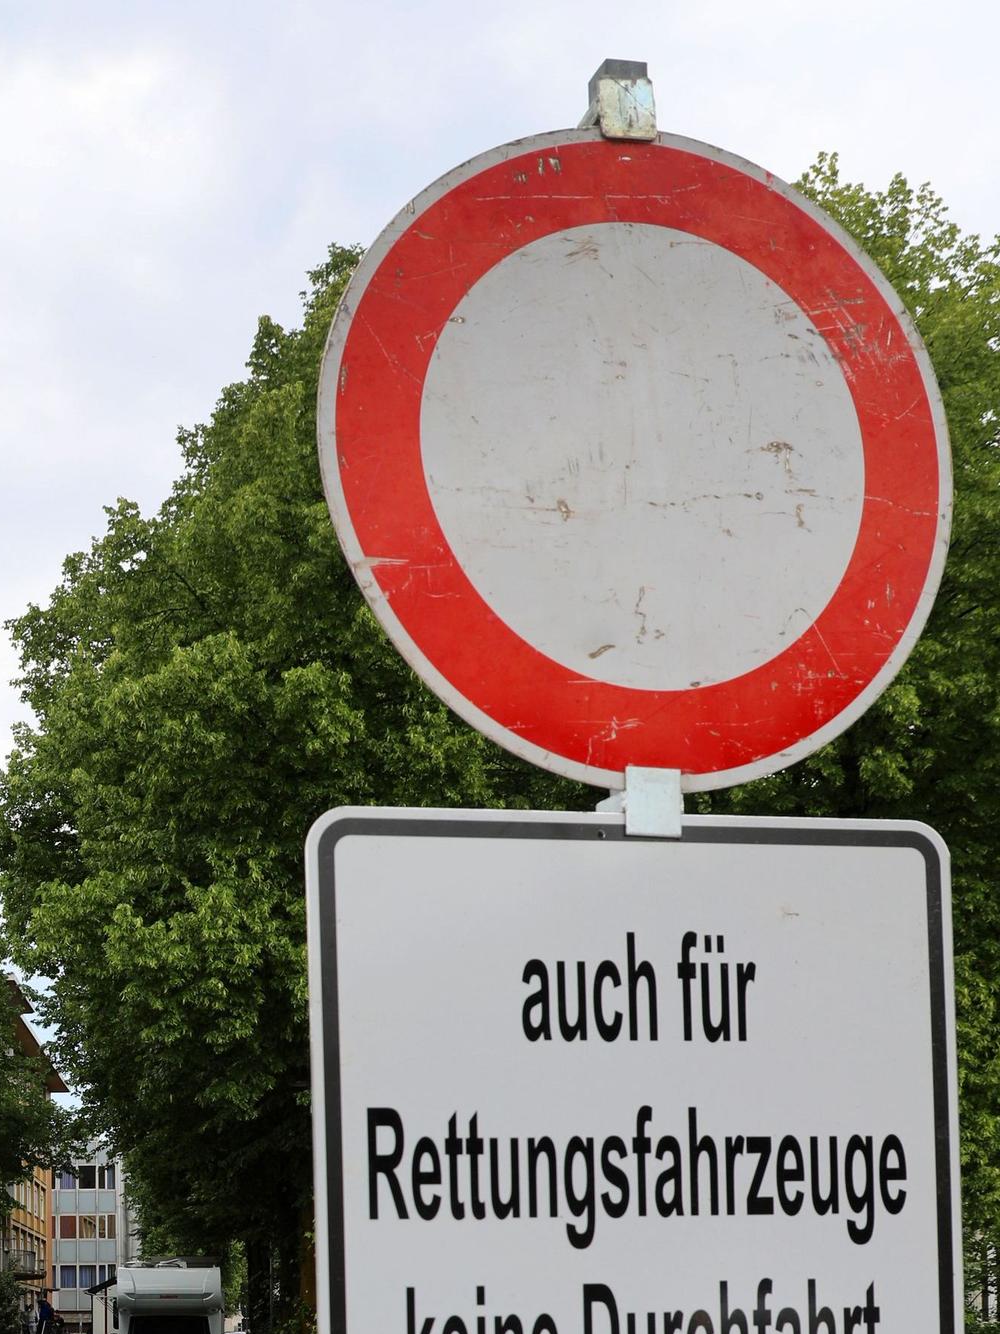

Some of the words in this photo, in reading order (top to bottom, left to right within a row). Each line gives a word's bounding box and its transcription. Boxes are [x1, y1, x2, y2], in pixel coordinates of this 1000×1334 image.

[522, 932, 658, 1042] auch
[677, 931, 756, 1043] für
[367, 1105, 907, 1249] Rettungsfahrzeuge
